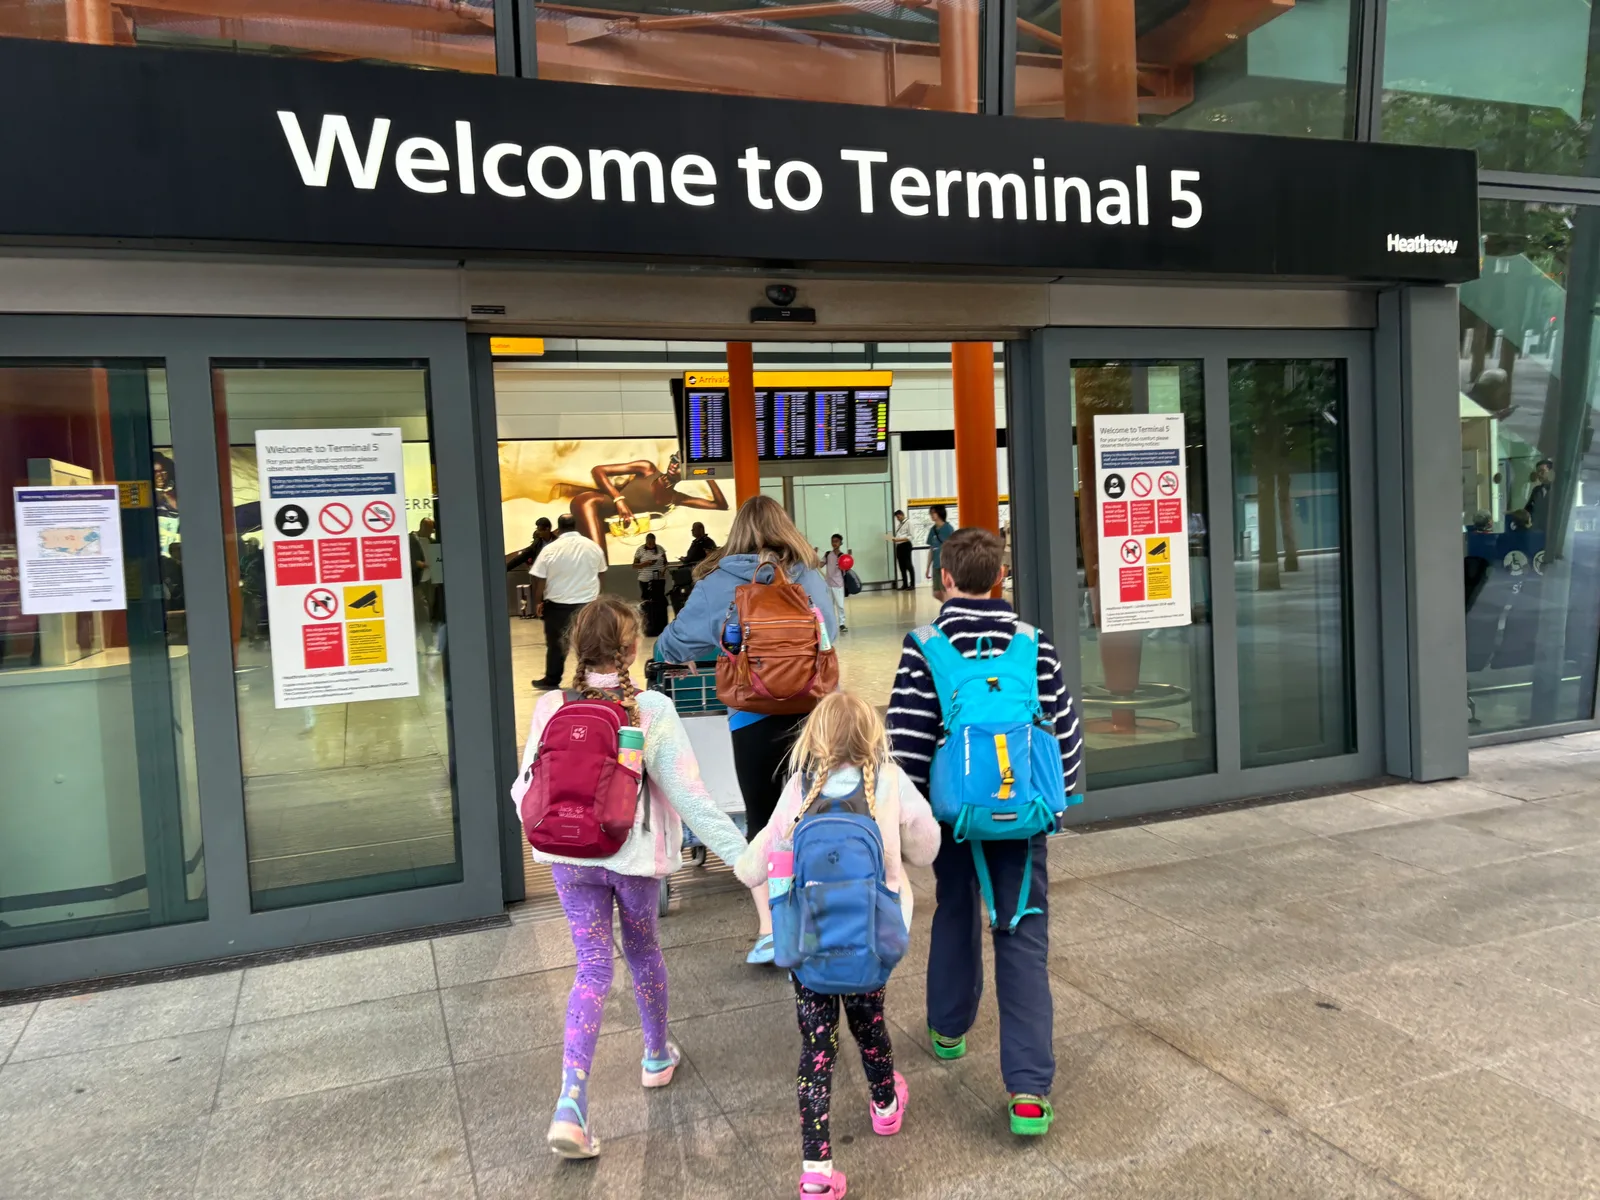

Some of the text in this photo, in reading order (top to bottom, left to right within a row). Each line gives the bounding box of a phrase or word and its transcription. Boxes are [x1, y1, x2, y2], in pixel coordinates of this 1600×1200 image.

[277, 111, 1203, 229] Welcome to Terminal 5
[1387, 233, 1459, 255] Heathrow
[265, 446, 313, 454] Welcome
[326, 444, 371, 452] Terminal
[372, 444, 379, 452] 5
